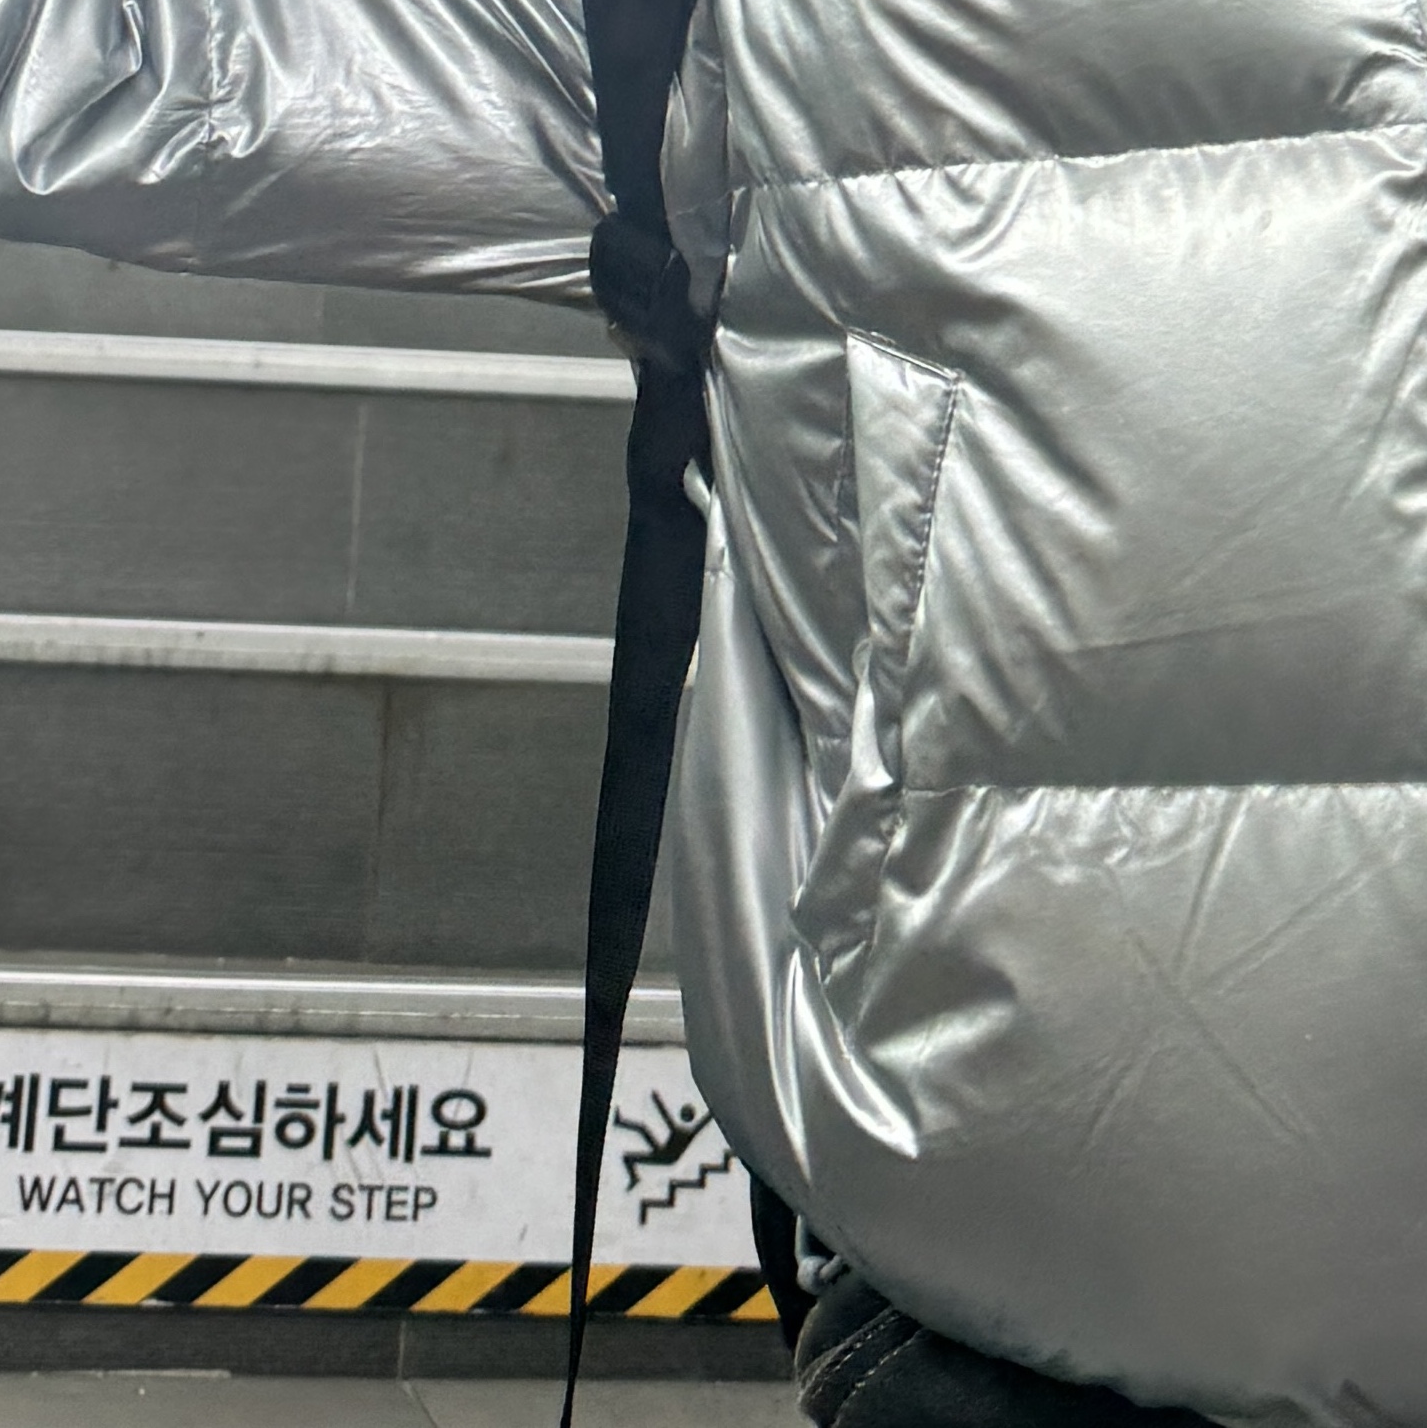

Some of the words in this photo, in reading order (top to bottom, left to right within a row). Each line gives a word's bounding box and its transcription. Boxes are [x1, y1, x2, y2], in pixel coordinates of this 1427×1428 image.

[19, 1174, 176, 1216] WATCH
[196, 1179, 312, 1220] YOUR
[330, 1182, 438, 1222] STEP
